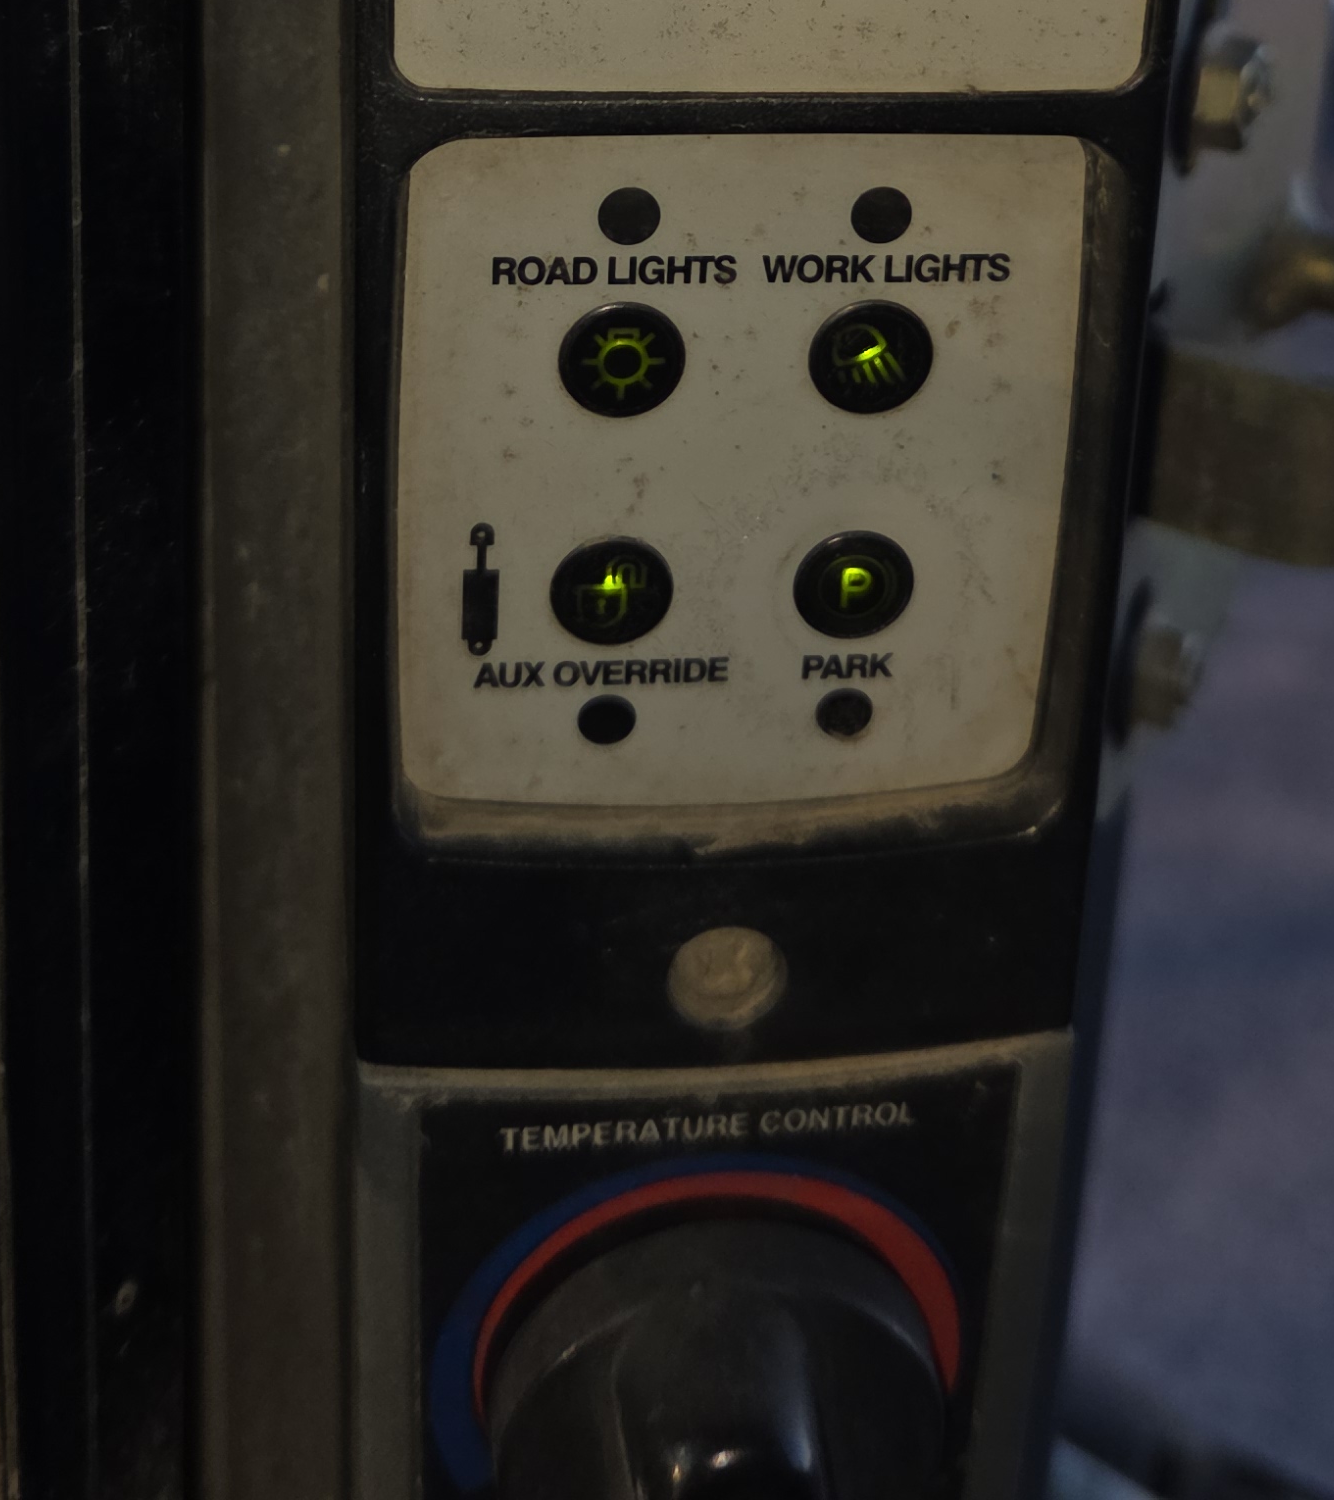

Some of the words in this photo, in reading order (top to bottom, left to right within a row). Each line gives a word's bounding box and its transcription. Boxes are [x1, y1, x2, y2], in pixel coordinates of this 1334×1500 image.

[491, 256, 598, 287] ROAD
[607, 255, 738, 286] LIGHTS
[763, 254, 876, 285] WORK
[884, 253, 1012, 283] LIGHTS
[841, 567, 872, 608] P
[474, 662, 546, 689] AUX
[553, 656, 730, 687] OVERRIDE
[801, 653, 894, 681] PARK
[499, 1112, 750, 1153] TEMPERATURE
[759, 1100, 915, 1135] CONTROL
